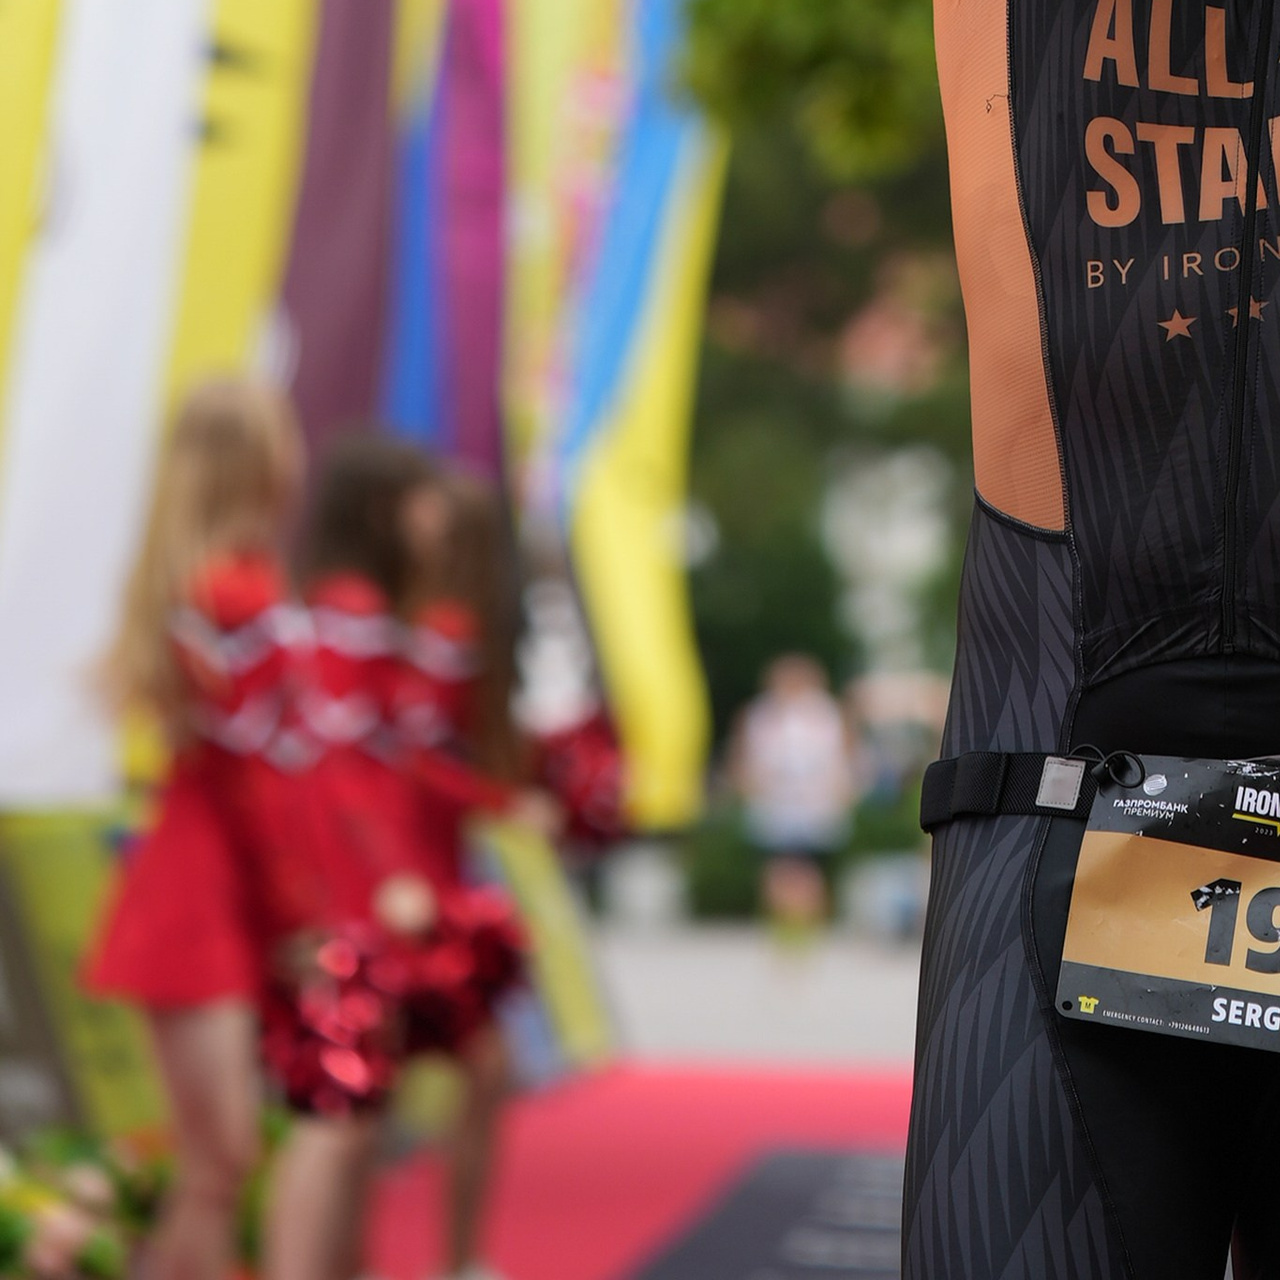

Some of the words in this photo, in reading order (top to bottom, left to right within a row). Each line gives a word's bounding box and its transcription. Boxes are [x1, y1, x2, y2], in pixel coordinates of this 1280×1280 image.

[1087, 258, 1135, 290] BY
[1113, 799, 1189, 814] ГАЗПРОМБАНК
[1123, 808, 1175, 820] ПРЕМИУМ
[1254, 827, 1274, 836] 2023
